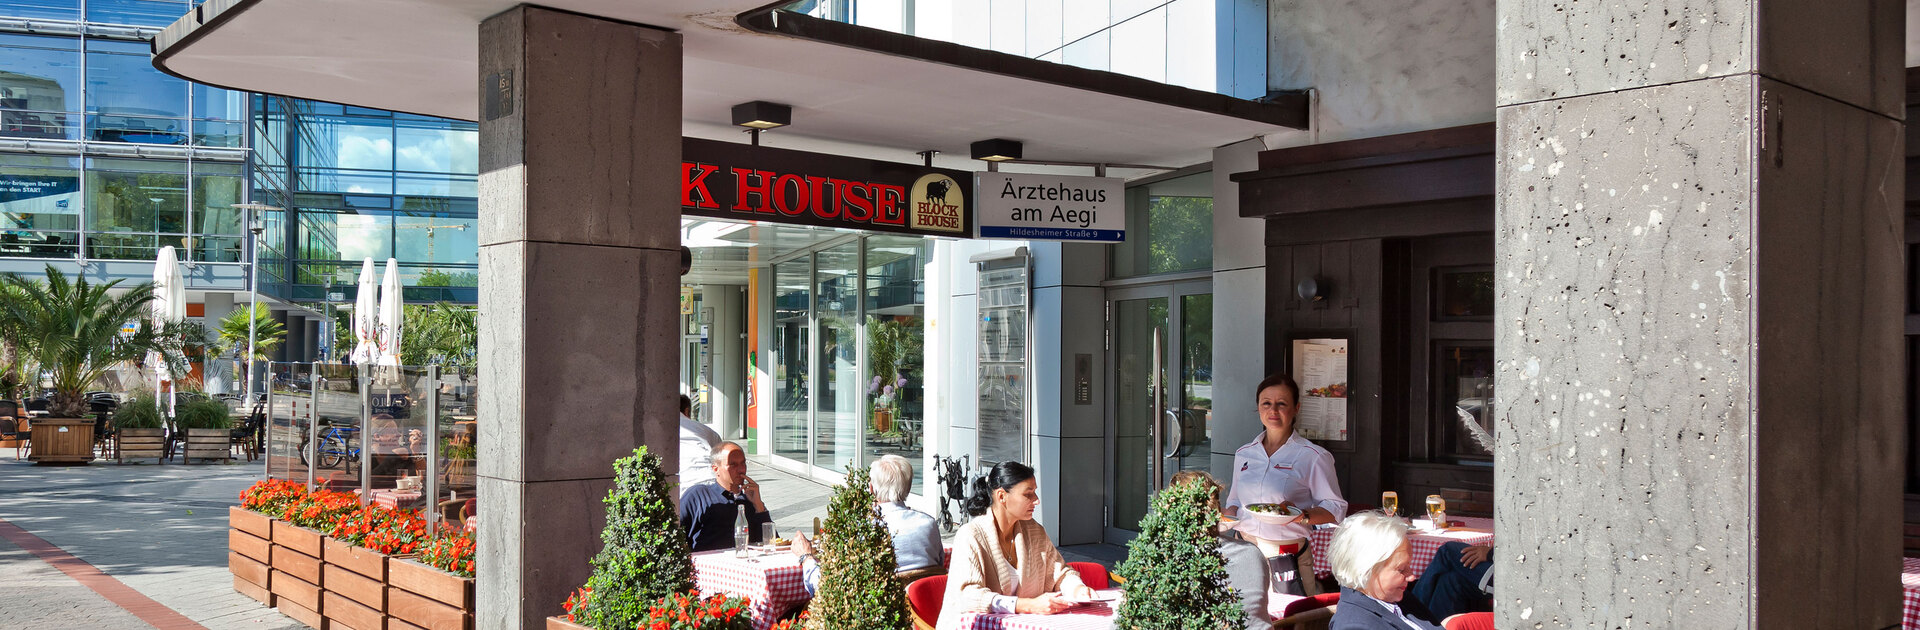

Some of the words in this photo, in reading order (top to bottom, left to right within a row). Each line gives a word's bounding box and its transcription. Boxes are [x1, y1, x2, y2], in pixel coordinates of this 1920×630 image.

[731, 166, 905, 226] HOUSE
[1001, 177, 1106, 203] Ärztehaus
[917, 202, 959, 217] BLOCK
[1011, 207, 1042, 222] am
[1050, 205, 1097, 228] Aegi
[917, 214, 959, 229] HOUSE
[1010, 228, 1062, 237] Hildesheimer
[1065, 229, 1091, 238] Straße
[1093, 230, 1098, 238] 9
